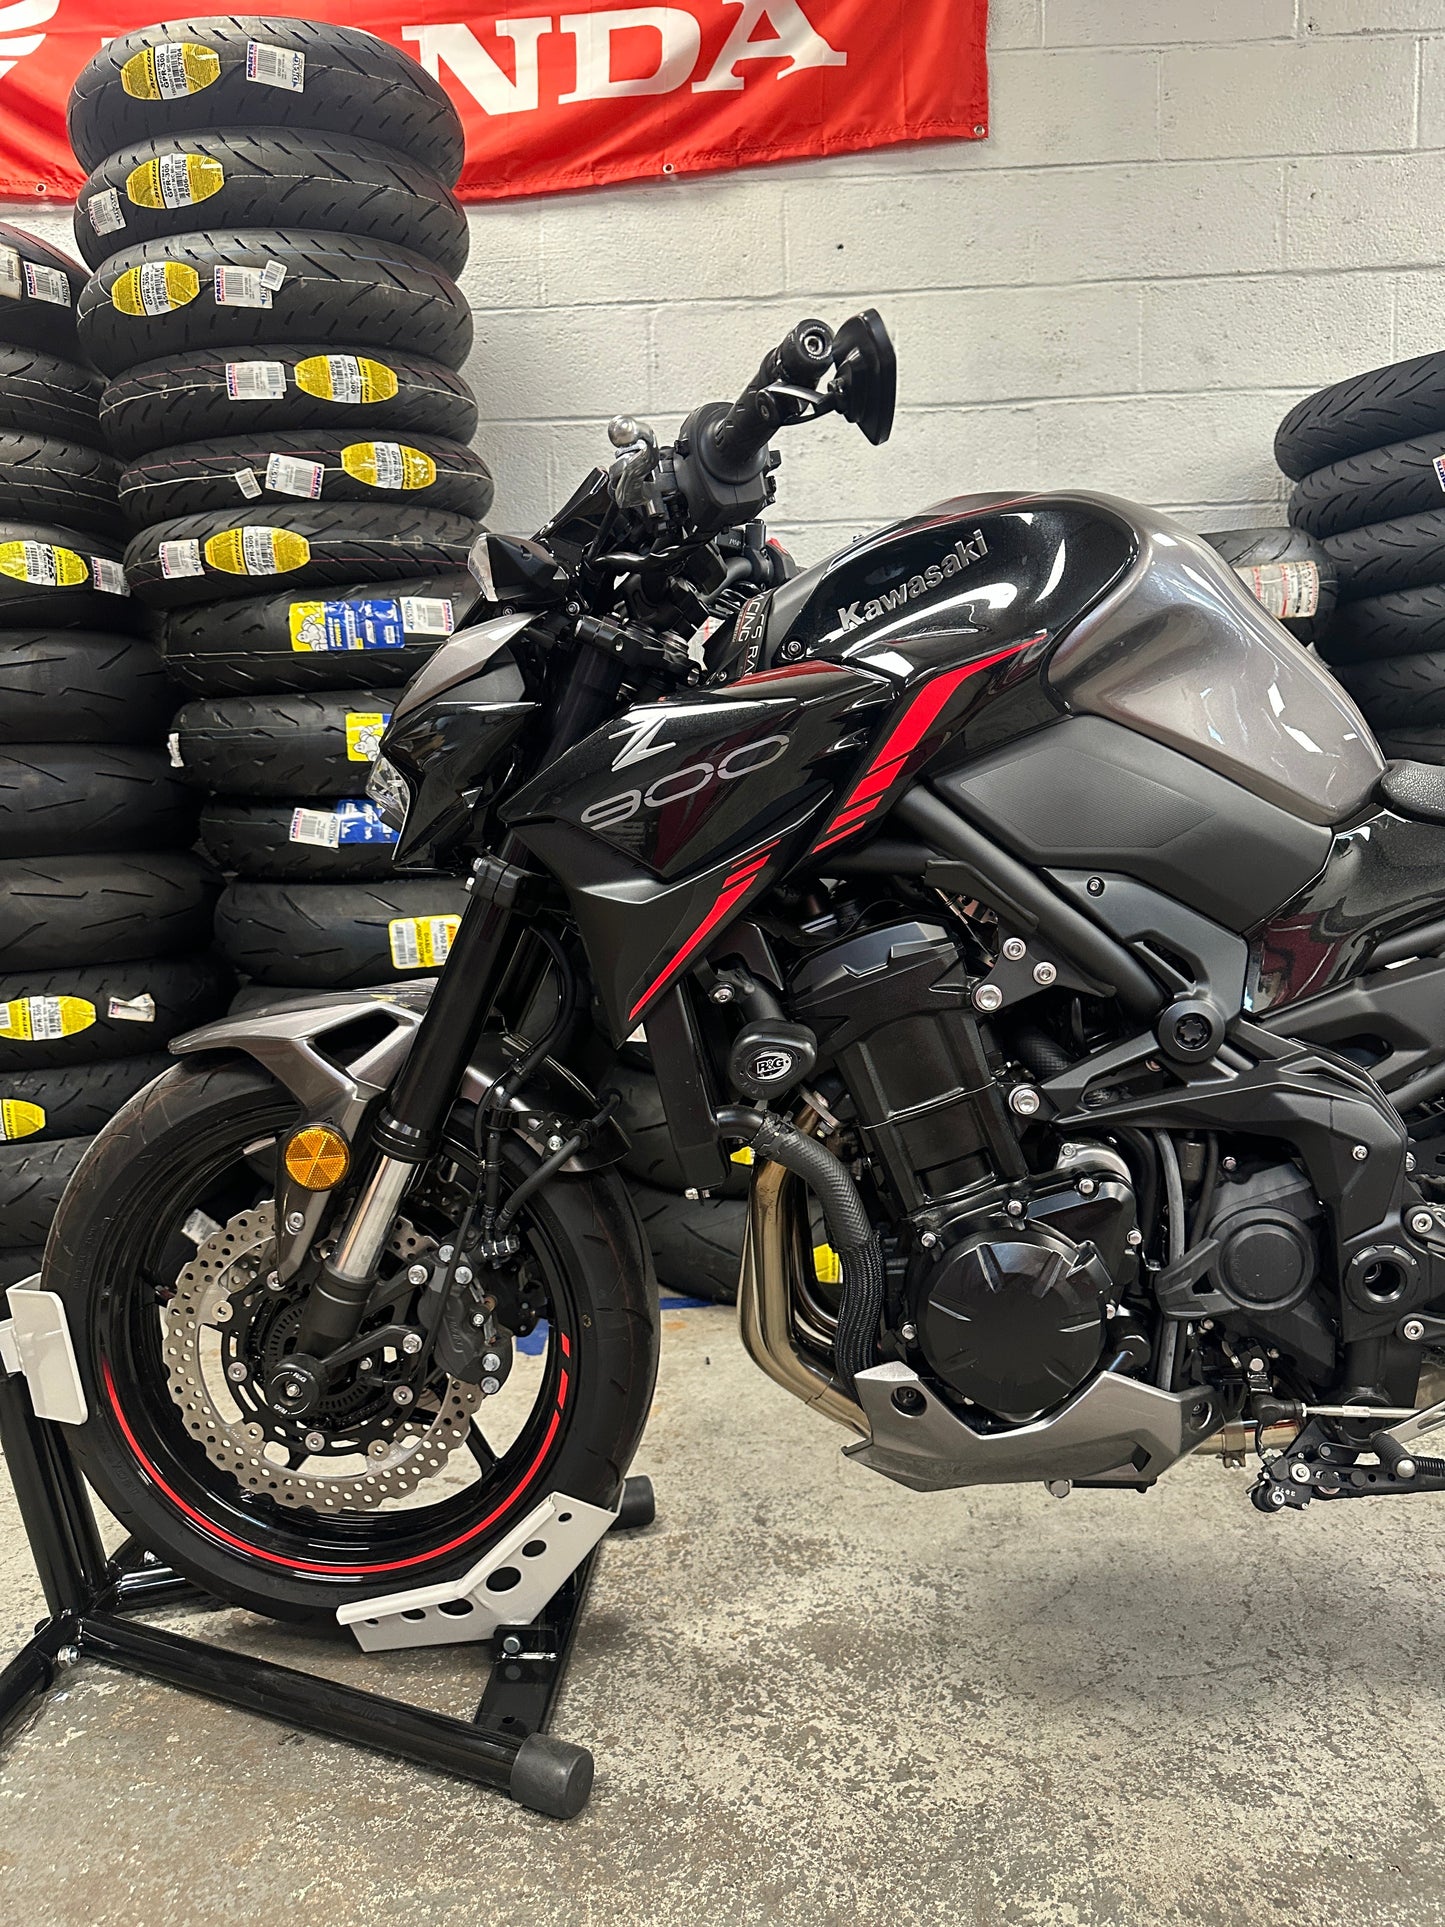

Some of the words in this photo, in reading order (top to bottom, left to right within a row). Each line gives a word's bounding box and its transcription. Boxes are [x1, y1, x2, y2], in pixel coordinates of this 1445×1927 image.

[147, 50, 155, 89] DUNLOP
[160, 53, 169, 88] GPR-300
[401, 0, 847, 115] NDA
[165, 163, 173, 197] GPR-300
[25, 264, 33, 295] PARTS
[144, 272, 153, 305] GPR-300
[249, 536, 257, 567] GPR-300
[838, 529, 988, 632] Kawasaki
[608, 714, 676, 772] Z
[581, 734, 790, 831] 900
[757, 1058, 785, 1074] R&G
